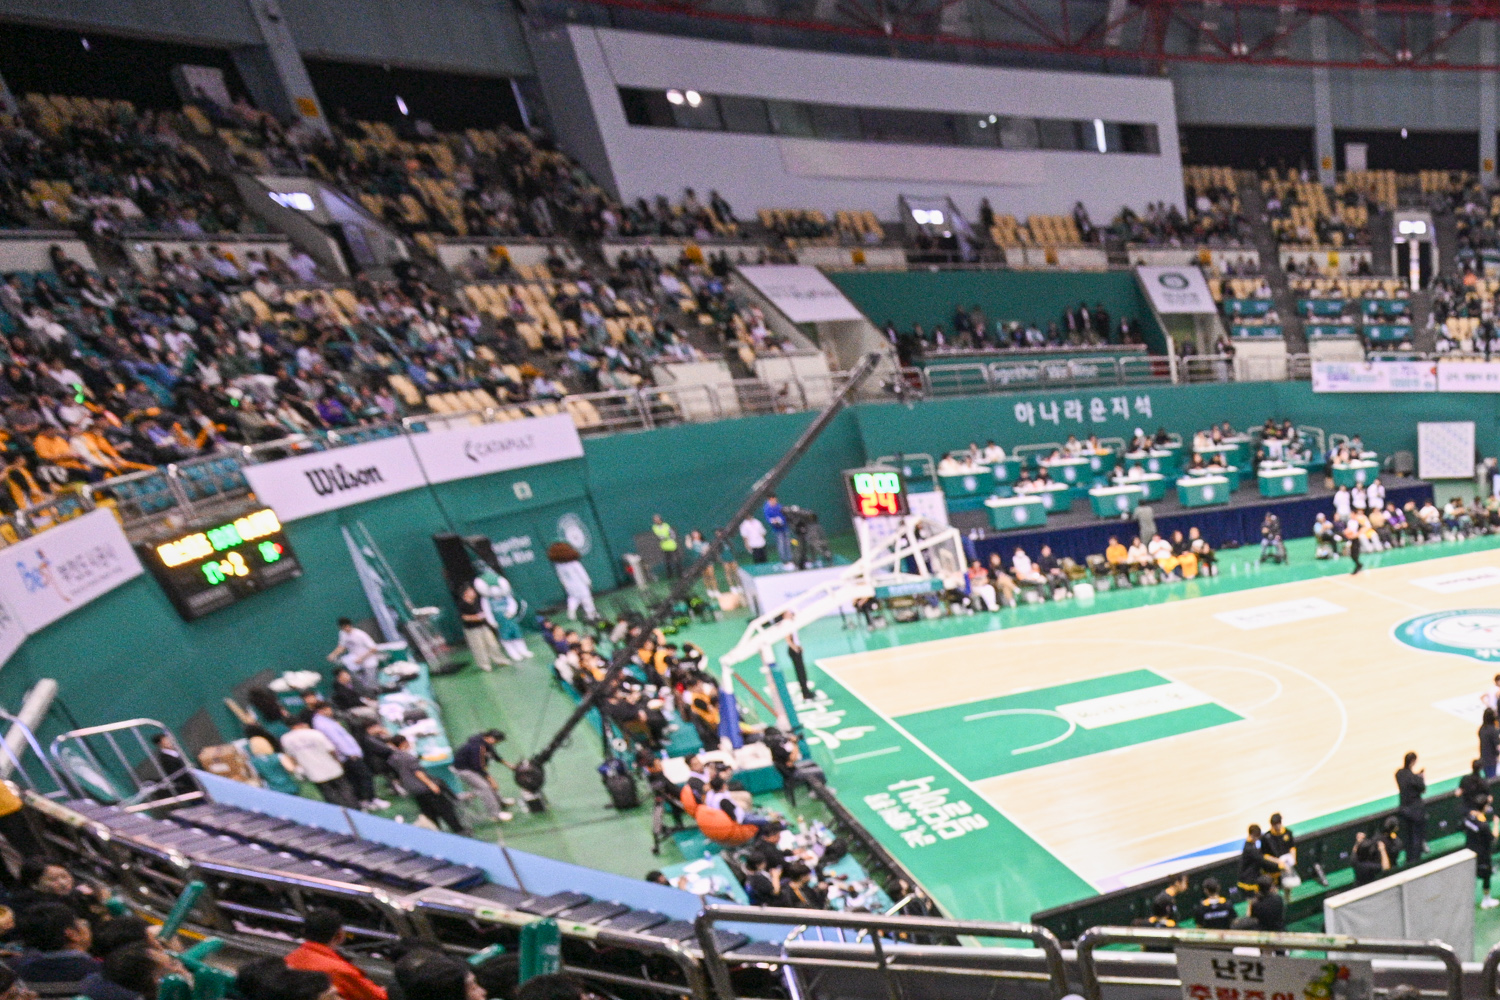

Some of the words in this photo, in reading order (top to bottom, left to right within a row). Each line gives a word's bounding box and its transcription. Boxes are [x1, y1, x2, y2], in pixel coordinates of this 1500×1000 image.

[1013, 394, 1153, 427] 하나라운지석
[303, 462, 386, 498] Wilson
[860, 493, 898, 517] 24
[1210, 957, 1266, 983] 난간
